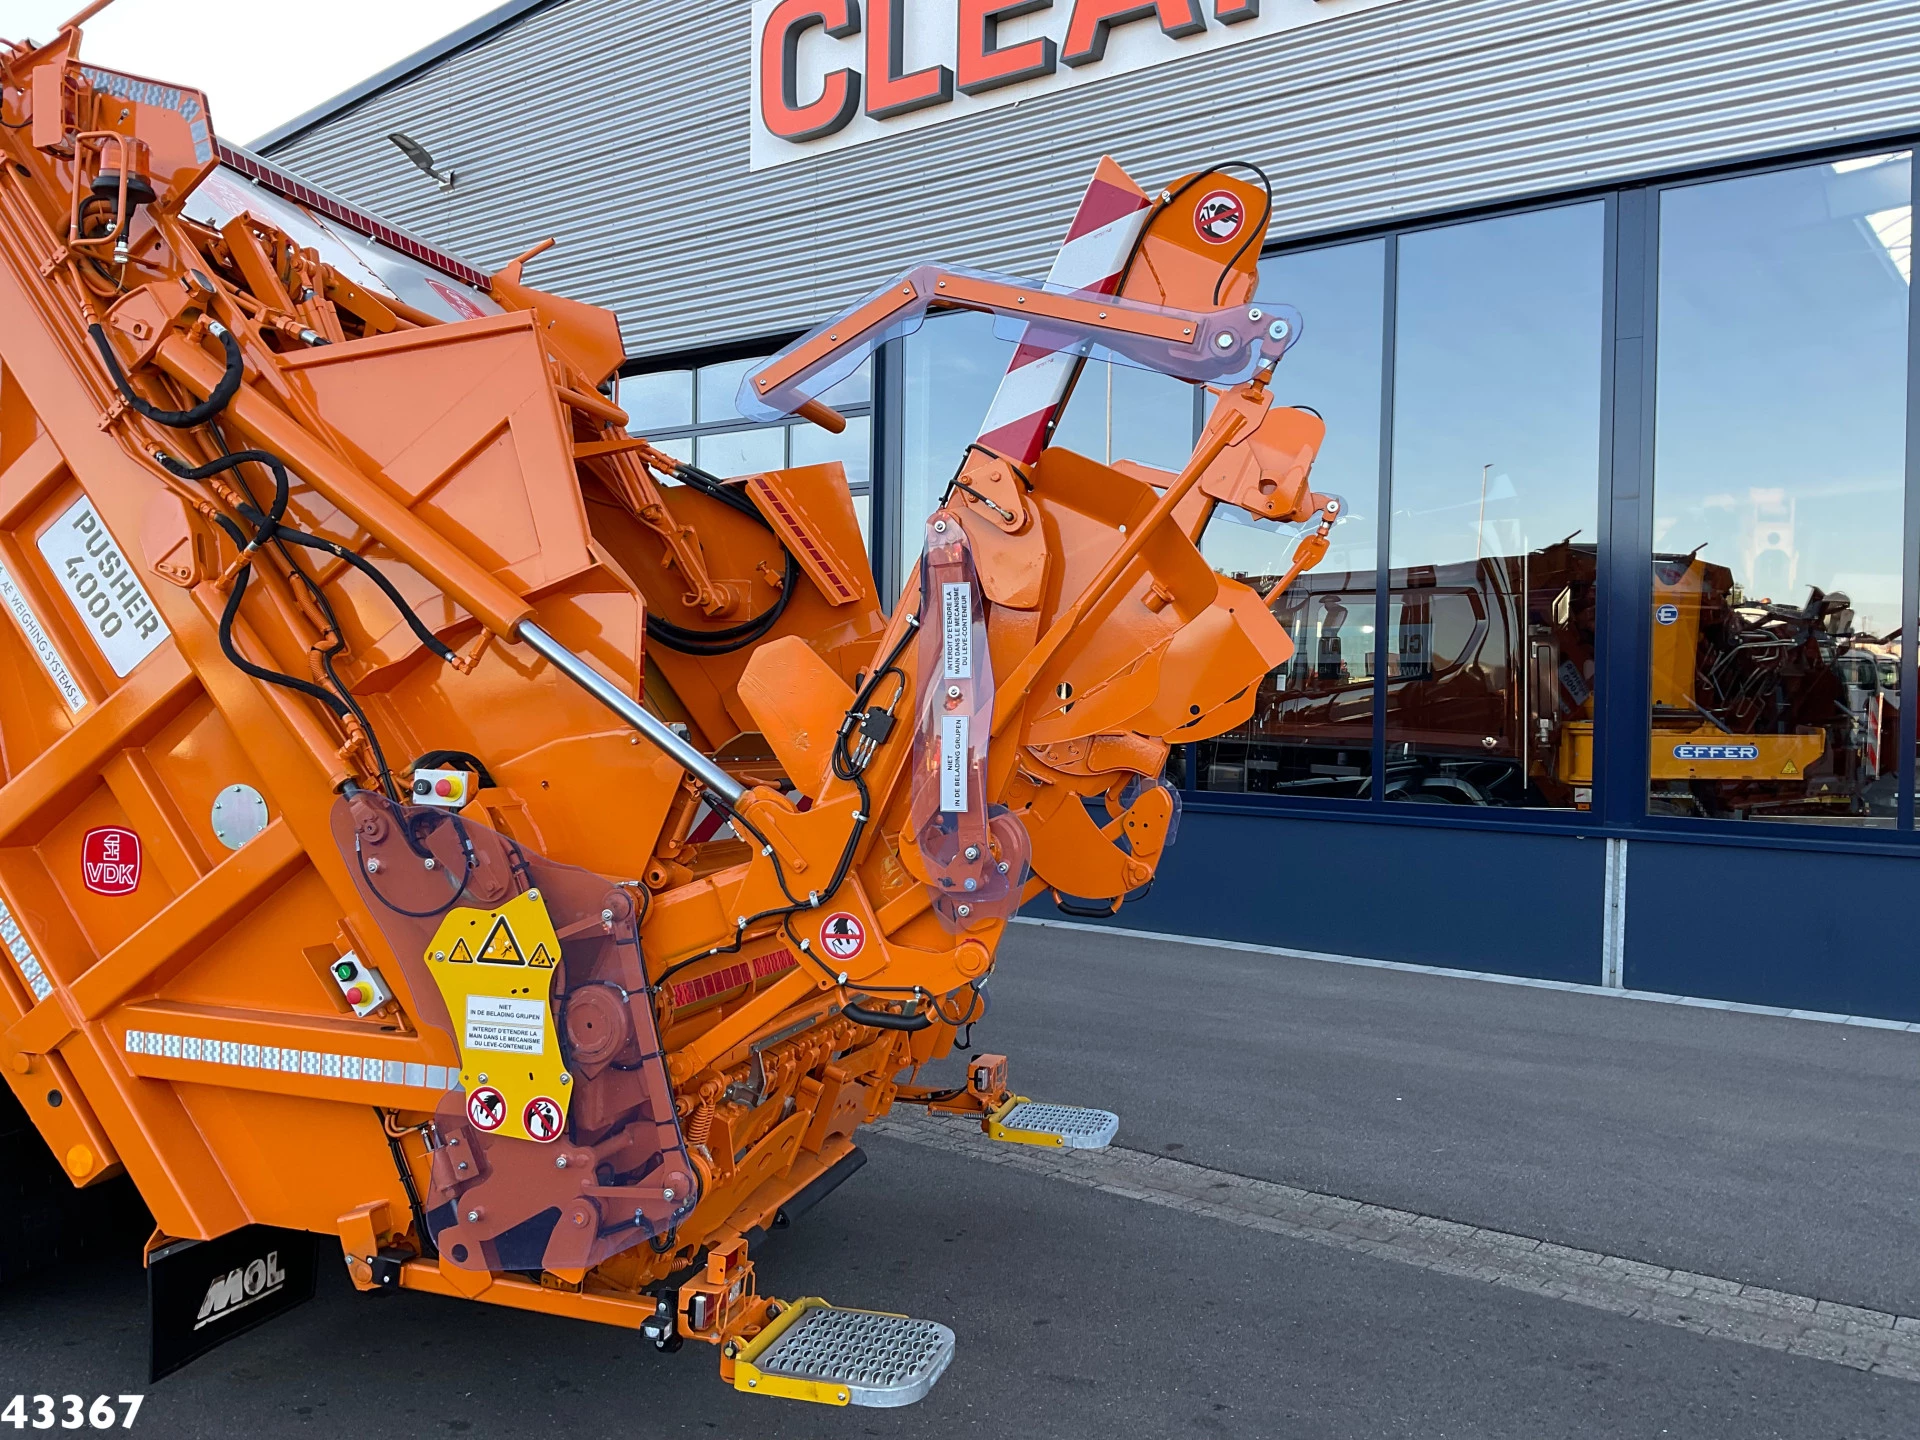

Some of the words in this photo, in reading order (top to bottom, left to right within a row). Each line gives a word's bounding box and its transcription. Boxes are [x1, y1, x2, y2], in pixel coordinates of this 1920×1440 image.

[72, 509, 159, 640] PUSHER
[65, 556, 122, 638] 4000
[946, 591, 952, 600] LA
[11, 594, 48, 652] WEIGHING
[954, 628, 960, 637] LE
[962, 656, 968, 666] DU
[1678, 746, 1754, 758] EFFER
[954, 788, 960, 798] DE
[954, 799, 960, 807] IN
[86, 862, 134, 884] VDK
[486, 1010, 515, 1018] BELADING
[472, 1026, 497, 1034] INTERDIT
[498, 1028, 529, 1036] D'ETENDRE
[507, 1036, 541, 1044] MECANISME
[483, 1041, 533, 1050] LEVE-CONTENEUR
[197, 1250, 285, 1320] MOL
